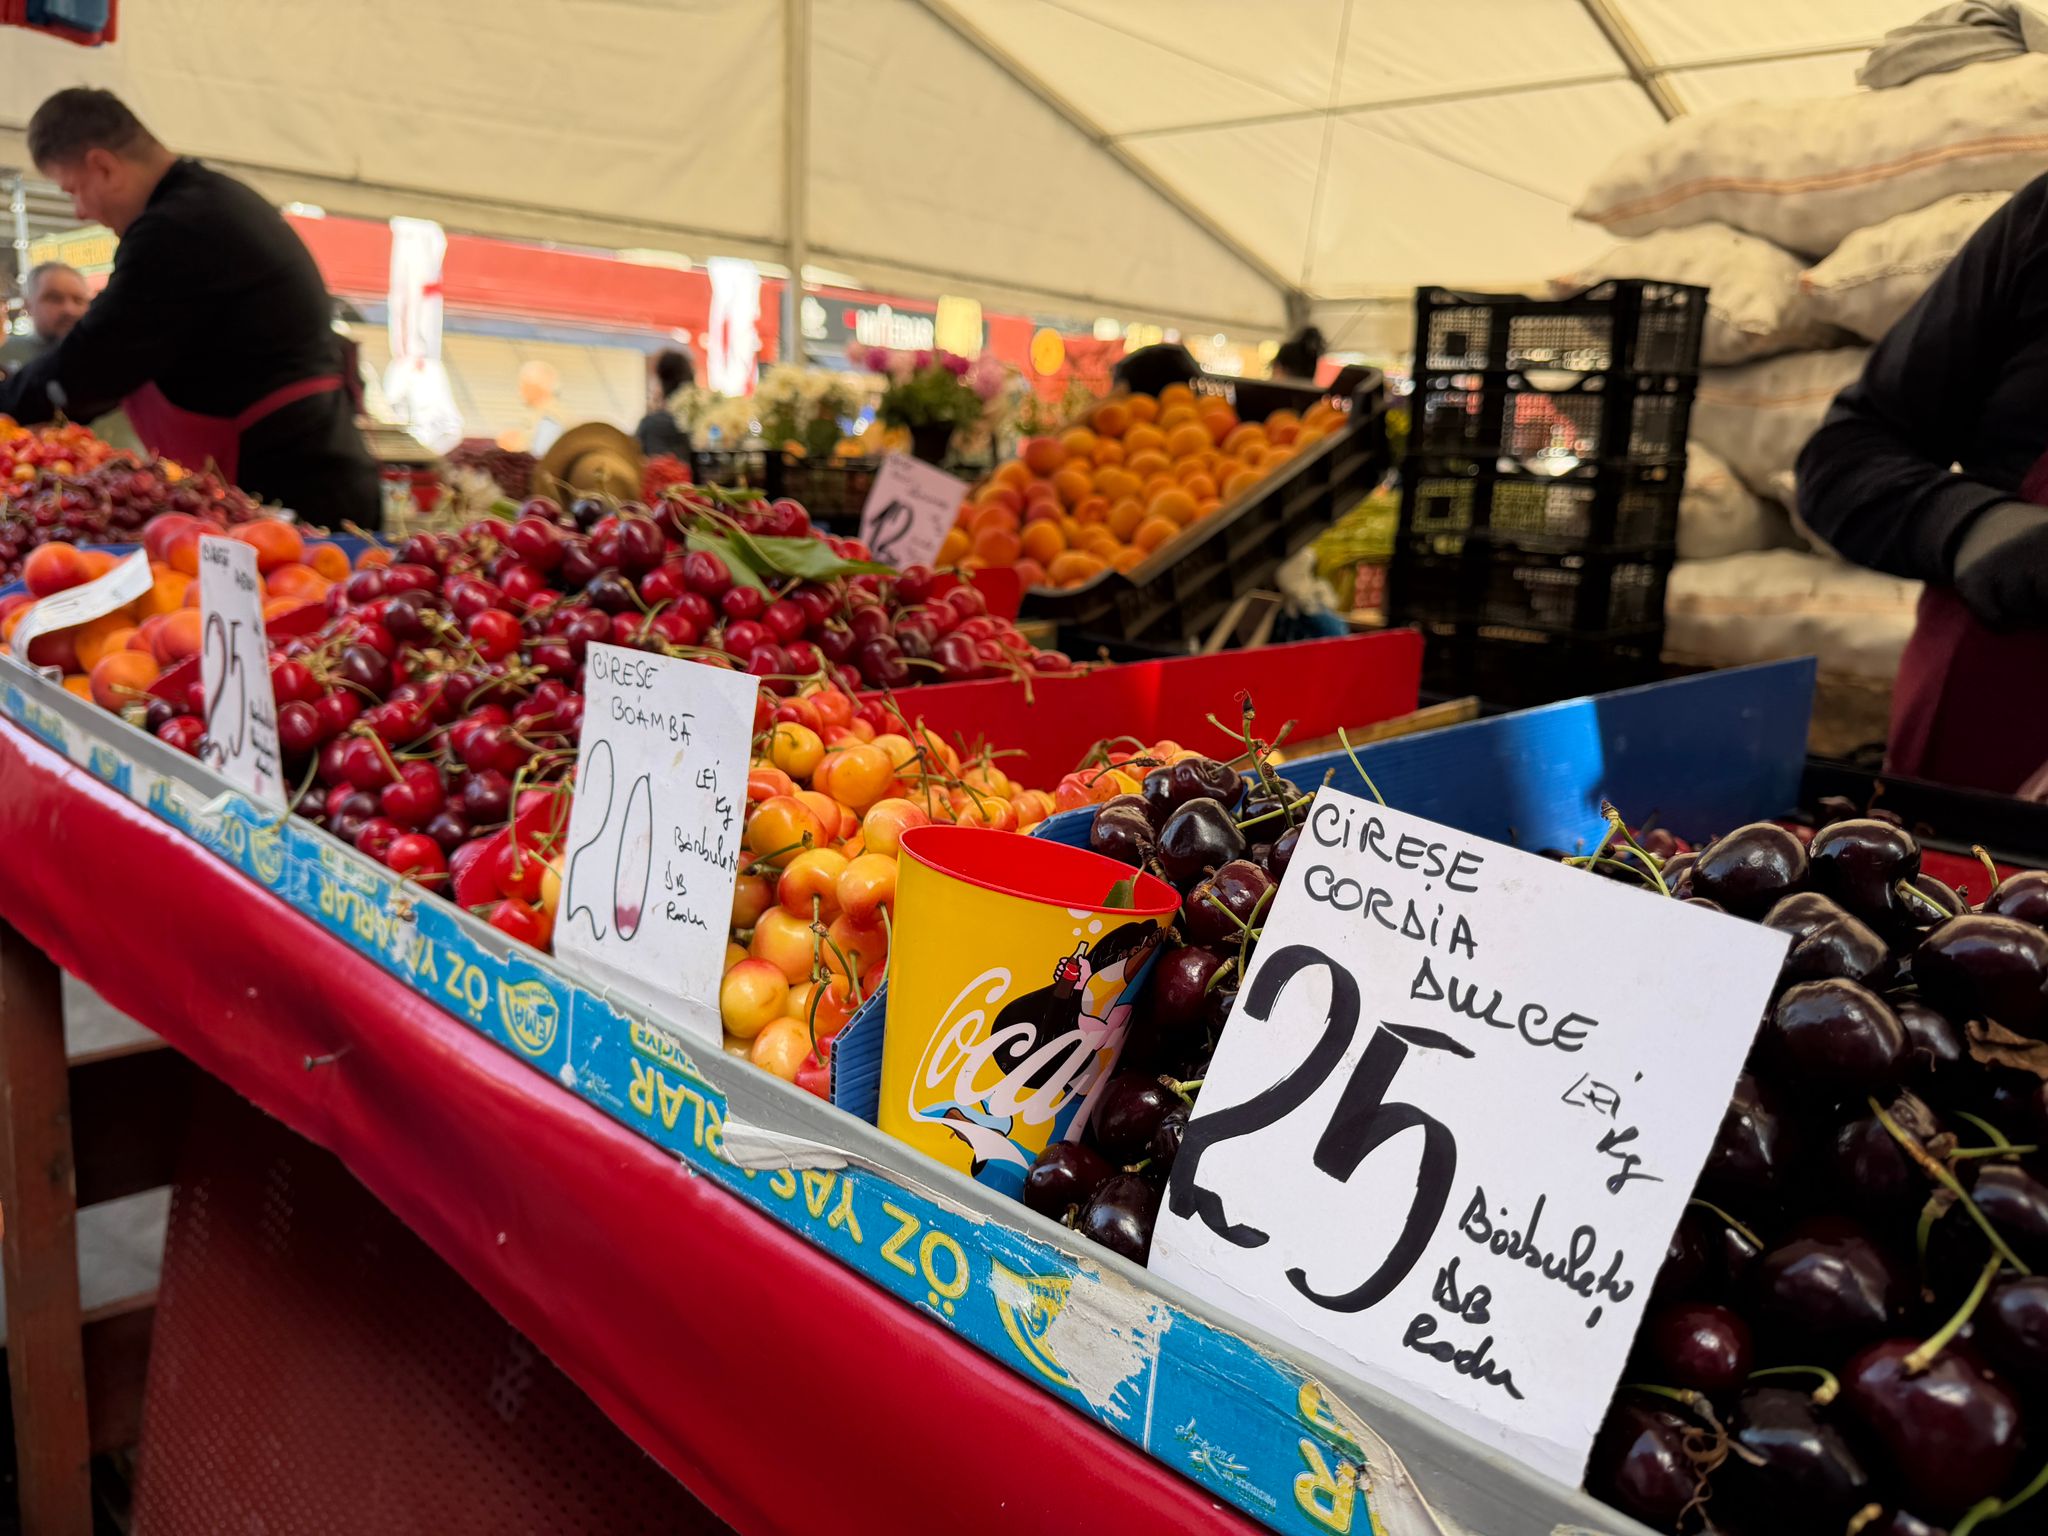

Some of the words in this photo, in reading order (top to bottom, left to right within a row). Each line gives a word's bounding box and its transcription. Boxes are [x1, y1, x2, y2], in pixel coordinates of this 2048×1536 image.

[867, 499, 915, 567] 12
[566, 739, 654, 942] 20
[445, 951, 489, 1022] ÖZ
[514, 1003, 548, 1041] EMA
[1410, 956, 1599, 1052] DULCE
[907, 966, 1098, 1130] Coca
[1167, 943, 1476, 1314] 25
[880, 1200, 971, 1317] ÖZ
